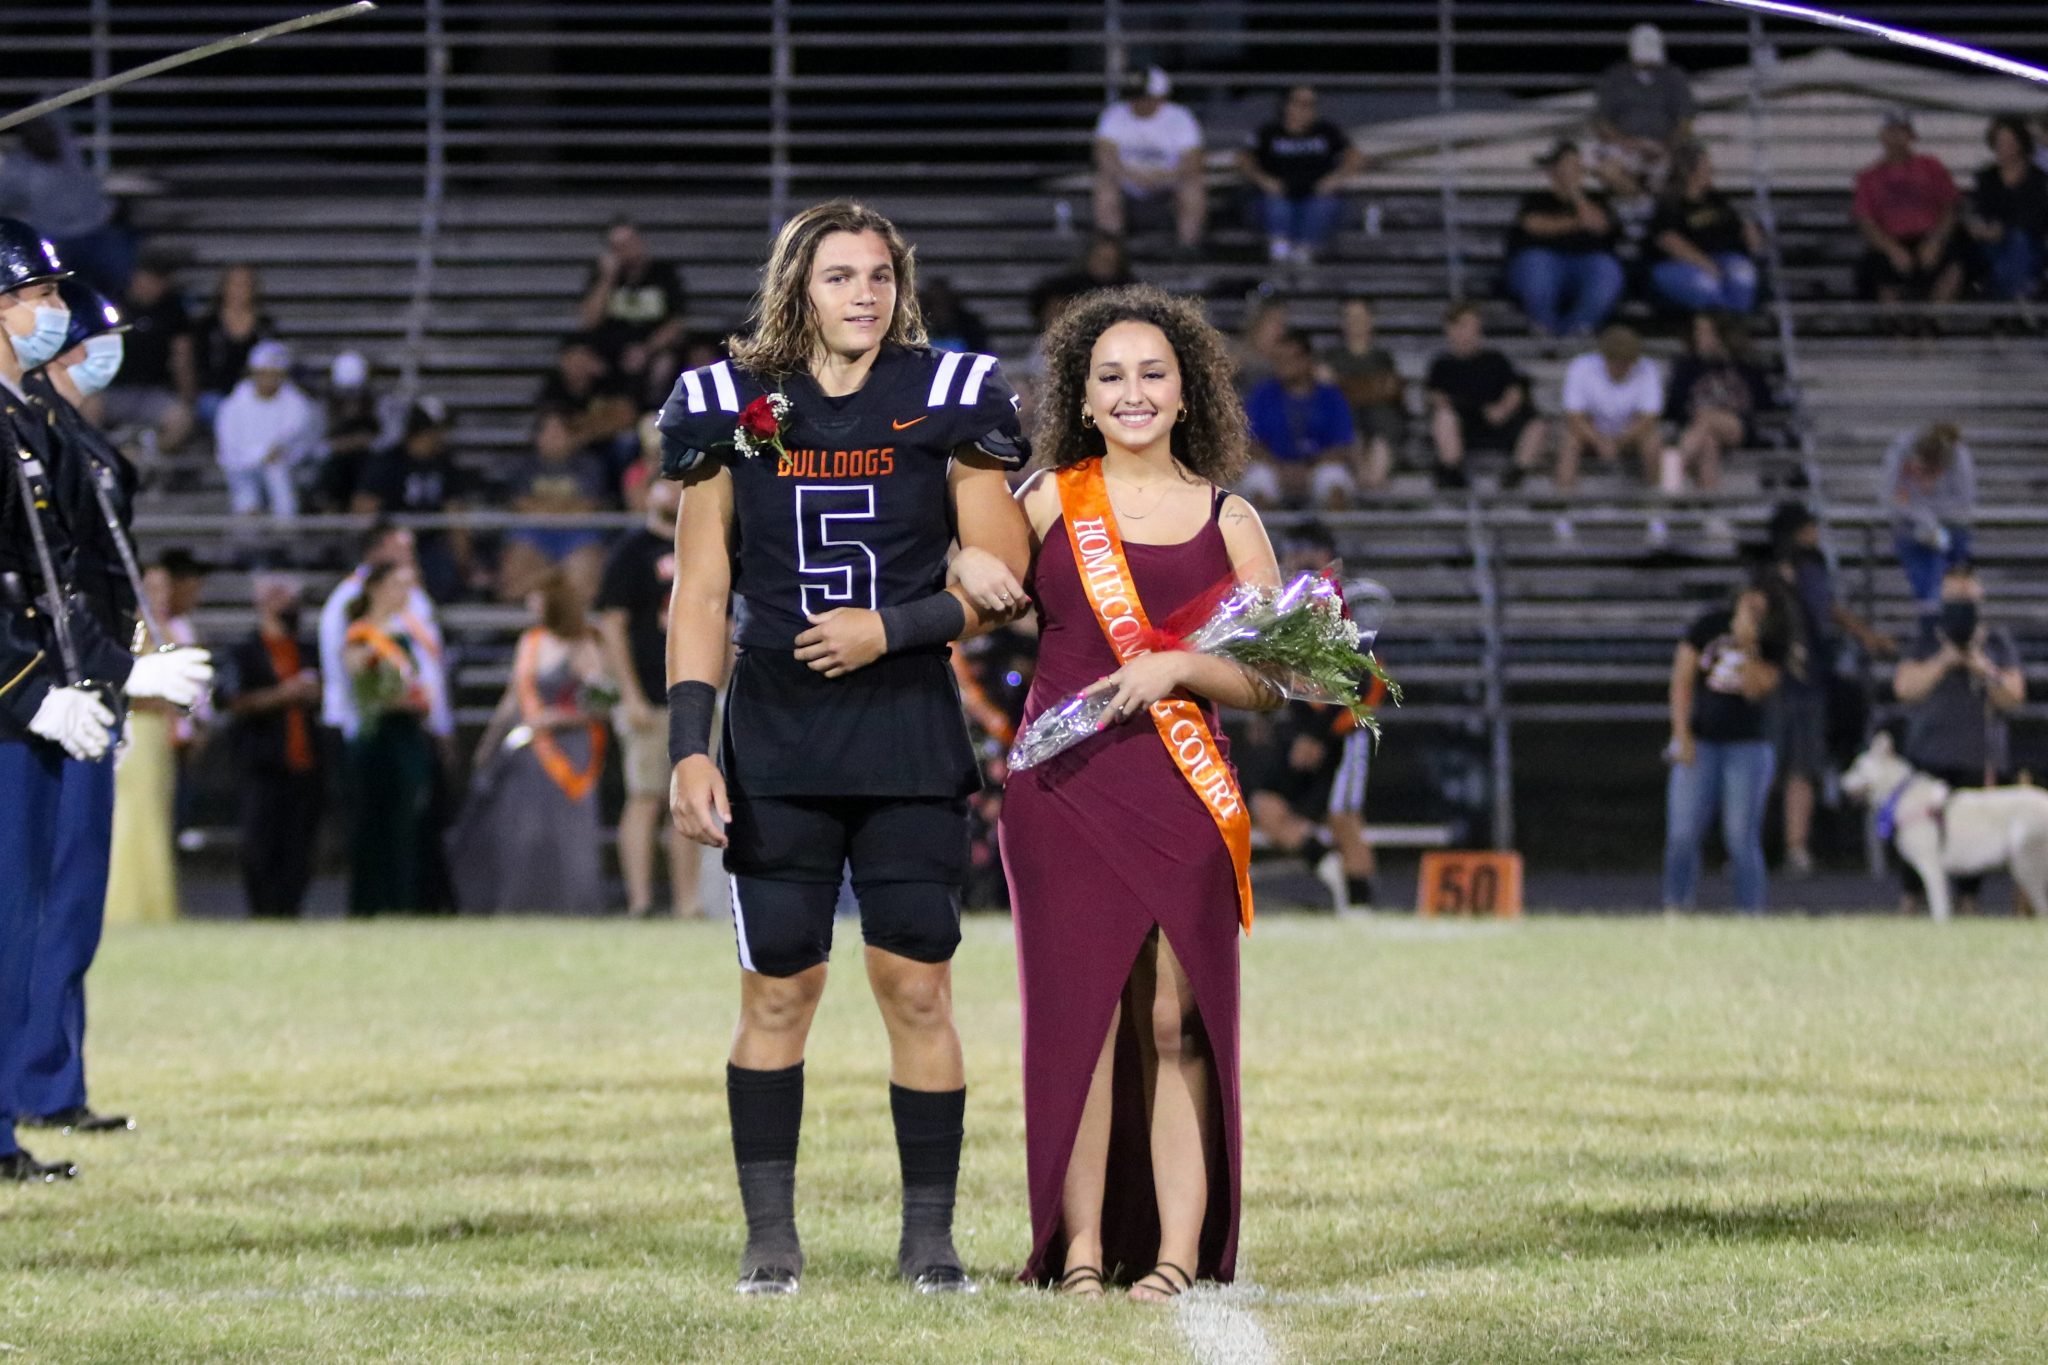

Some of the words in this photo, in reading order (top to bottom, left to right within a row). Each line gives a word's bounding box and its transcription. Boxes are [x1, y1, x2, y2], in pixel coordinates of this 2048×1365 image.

[777, 448, 895, 478] BULLDOGS
[795, 484, 877, 617] 5
[1169, 719, 1241, 821] COURT
[1438, 864, 1498, 915] 50
